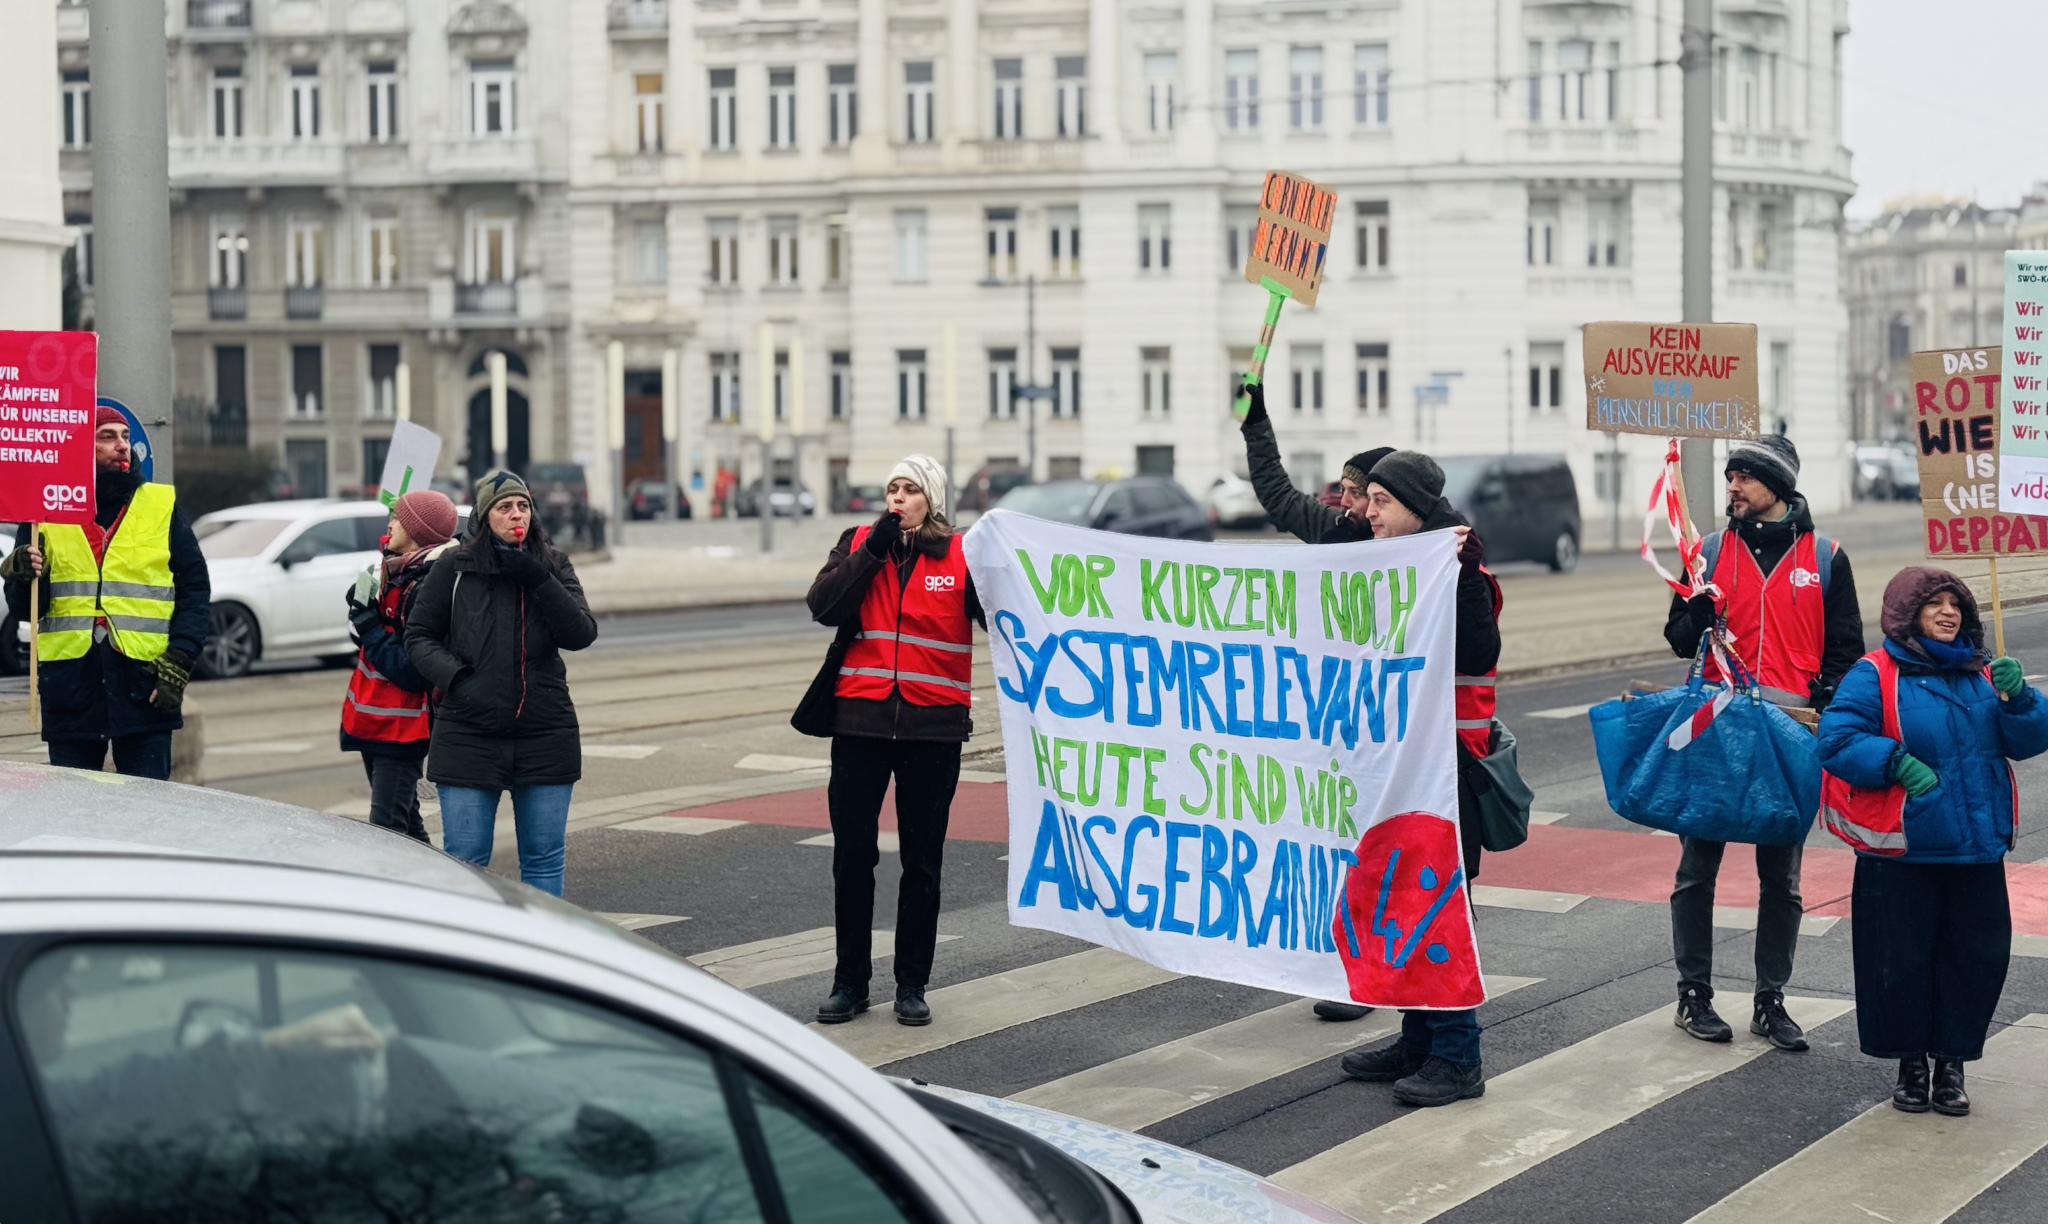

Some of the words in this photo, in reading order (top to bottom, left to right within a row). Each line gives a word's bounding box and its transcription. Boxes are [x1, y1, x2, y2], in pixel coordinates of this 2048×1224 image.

[2017, 263, 2032, 271] Wir
[2017, 273, 2048, 282] SWÖ-K
[2016, 302, 2044, 316] Wir
[1650, 326, 1701, 352] KEIN
[2015, 326, 2043, 340] Wir
[1603, 347, 1740, 379] AUSVERKAUF
[1943, 350, 1989, 374] DAS
[2014, 351, 2042, 366] Wir
[0, 383, 60, 402] ÄMPFEN
[1653, 379, 1693, 399] DER
[2013, 376, 2041, 390] Wir
[1915, 374, 2001, 416] ROT
[0, 404, 19, 421] ÜR
[22, 407, 89, 424] UNSEREN
[2012, 400, 2041, 415] Wir
[0, 427, 73, 443] OLLEKTIV-
[1917, 414, 1995, 456] WIE
[2012, 425, 2040, 440] Wir
[0, 447, 59, 463] ERTRAG!
[1966, 453, 1996, 479] IS
[43, 484, 87, 511] gpa
[924, 575, 955, 592] gpa
[1016, 549, 1116, 619] VOR
[1140, 558, 1297, 639] KURZEM
[1320, 566, 1417, 654] NOCH
[994, 608, 1426, 751] SYSTEMRELEVANT
[1030, 725, 1167, 817] HEUTE
[1018, 798, 1361, 958] AUSGEBRANNT
